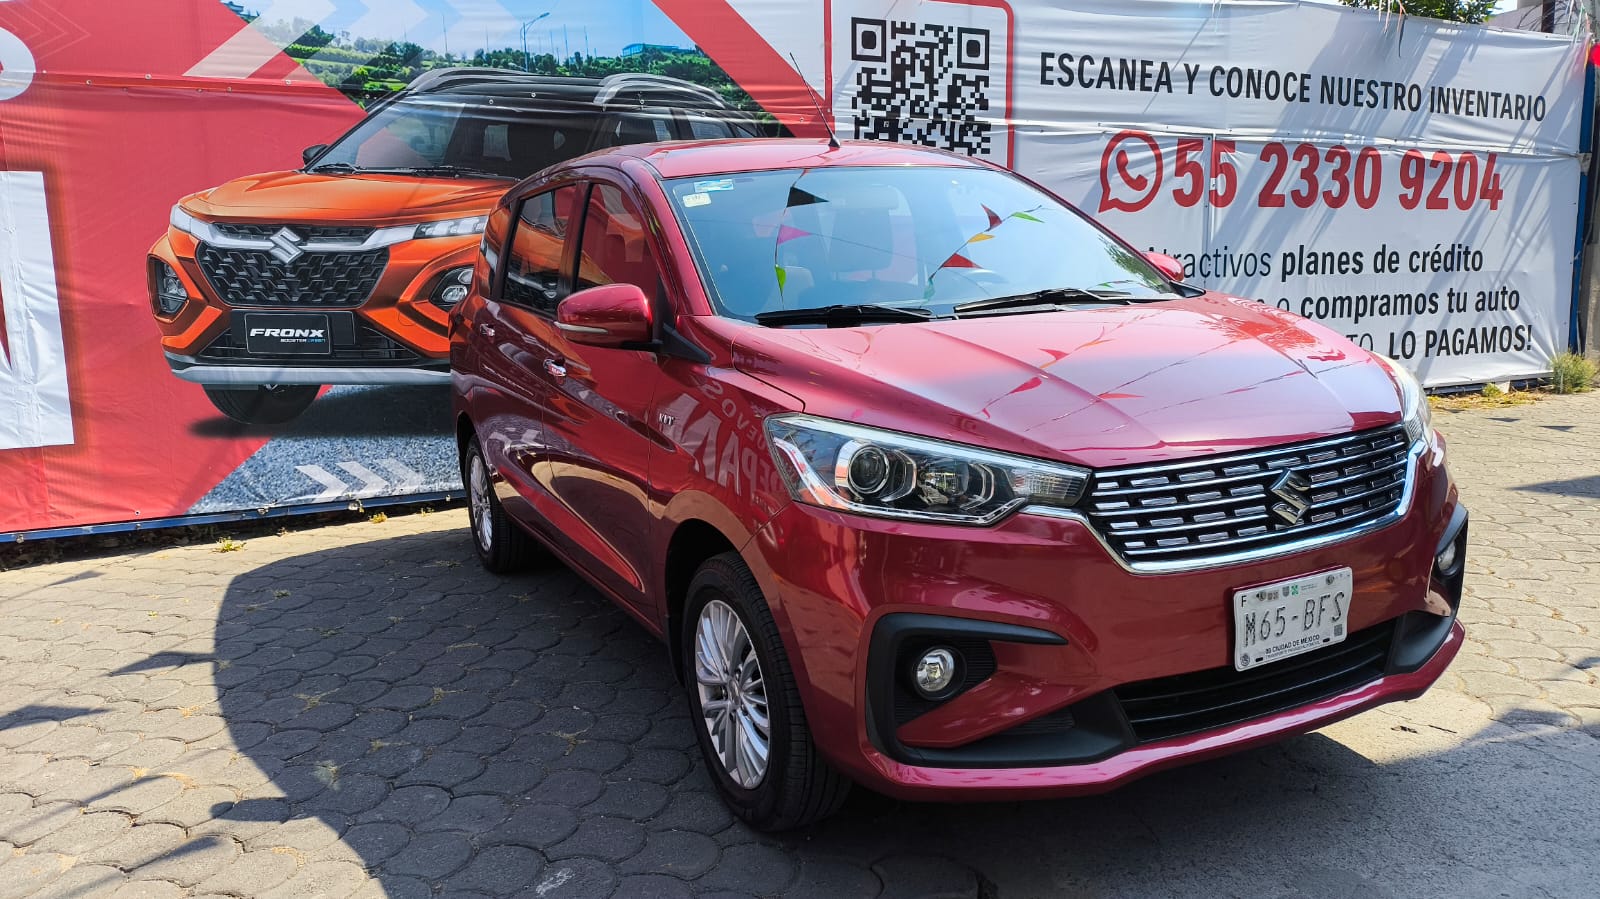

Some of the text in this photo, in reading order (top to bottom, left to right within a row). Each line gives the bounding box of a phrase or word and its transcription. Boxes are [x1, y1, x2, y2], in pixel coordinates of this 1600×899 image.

[1040, 51, 1546, 122] ESCANEA Y CONOCE NUESTRO INVENTARIO
[1172, 138, 1504, 211] 55 2330 9204
[1281, 244, 1364, 282] planes
[1373, 243, 1400, 274] de
[1408, 243, 1484, 273] crédito
[1301, 291, 1440, 325] compramos
[1447, 287, 1468, 314] tu
[1474, 286, 1520, 313] auto
[249, 328, 325, 338] FRONX
[1388, 330, 1416, 360] LO
[1424, 324, 1533, 358] PAGAMOS!
[1240, 595, 1247, 608] F
[1244, 591, 1345, 648] M65-BFS
